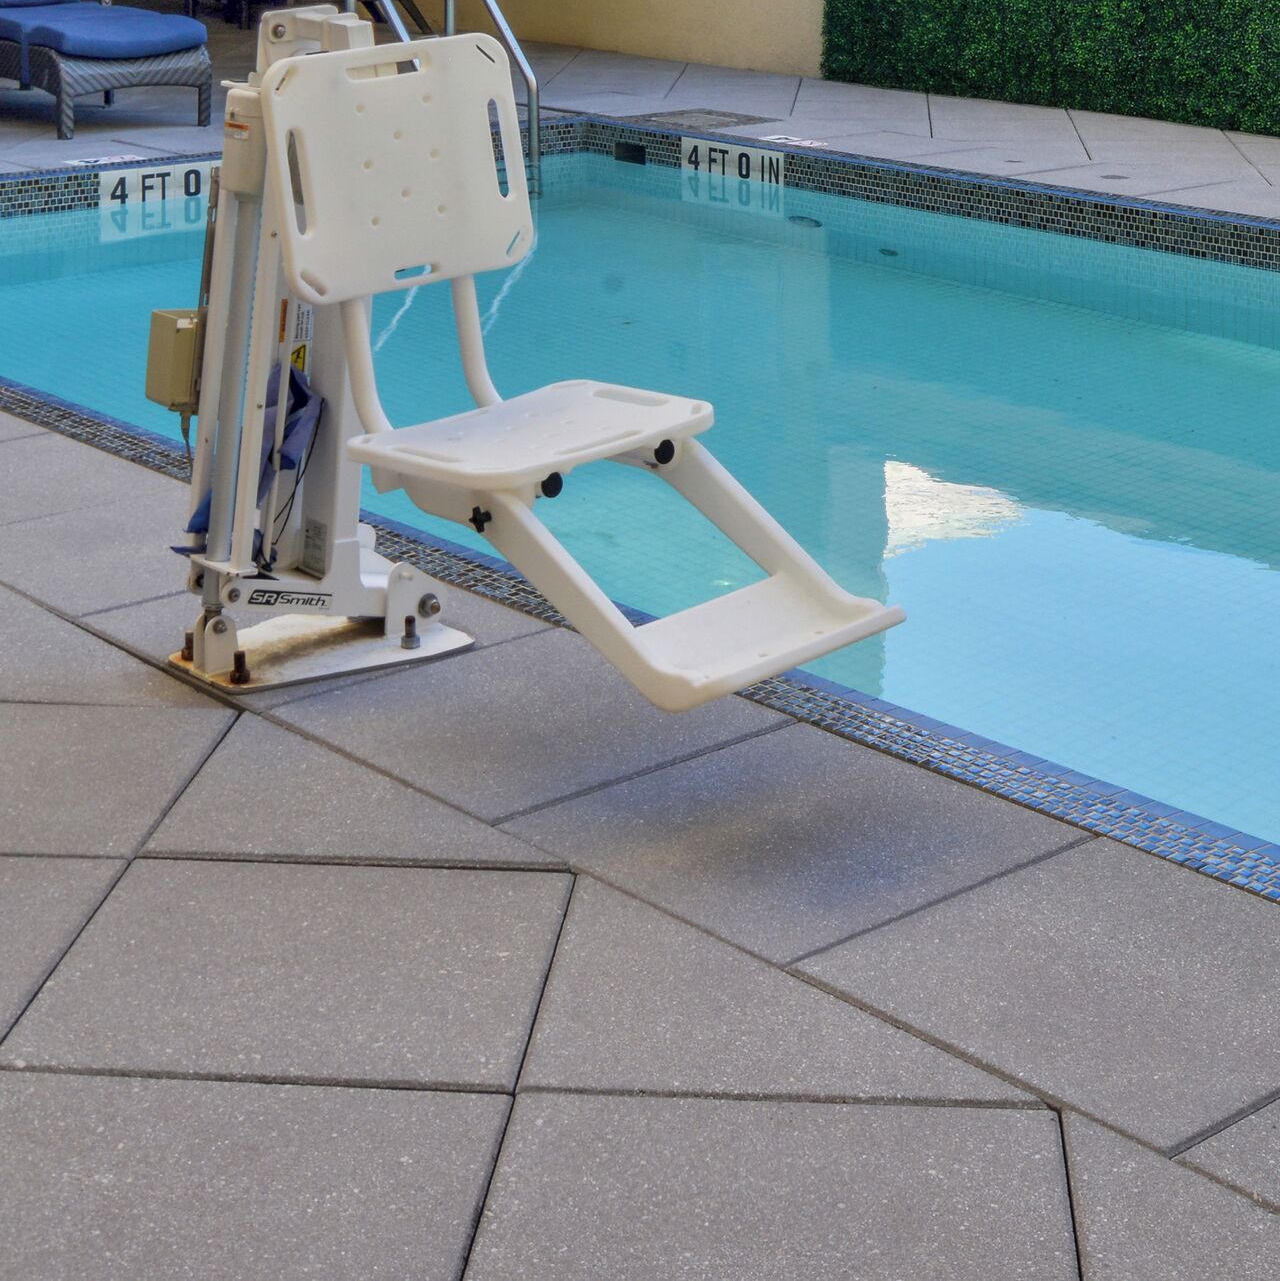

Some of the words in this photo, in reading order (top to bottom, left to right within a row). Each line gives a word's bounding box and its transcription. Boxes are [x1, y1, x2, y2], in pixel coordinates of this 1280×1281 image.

[687, 145, 700, 171] 4
[708, 147, 729, 176] FT
[761, 155, 780, 185] IN
[110, 176, 129, 205] 4
[141, 172, 171, 203] FT
[250, 591, 277, 604] SR
[278, 593, 326, 606] Smith
